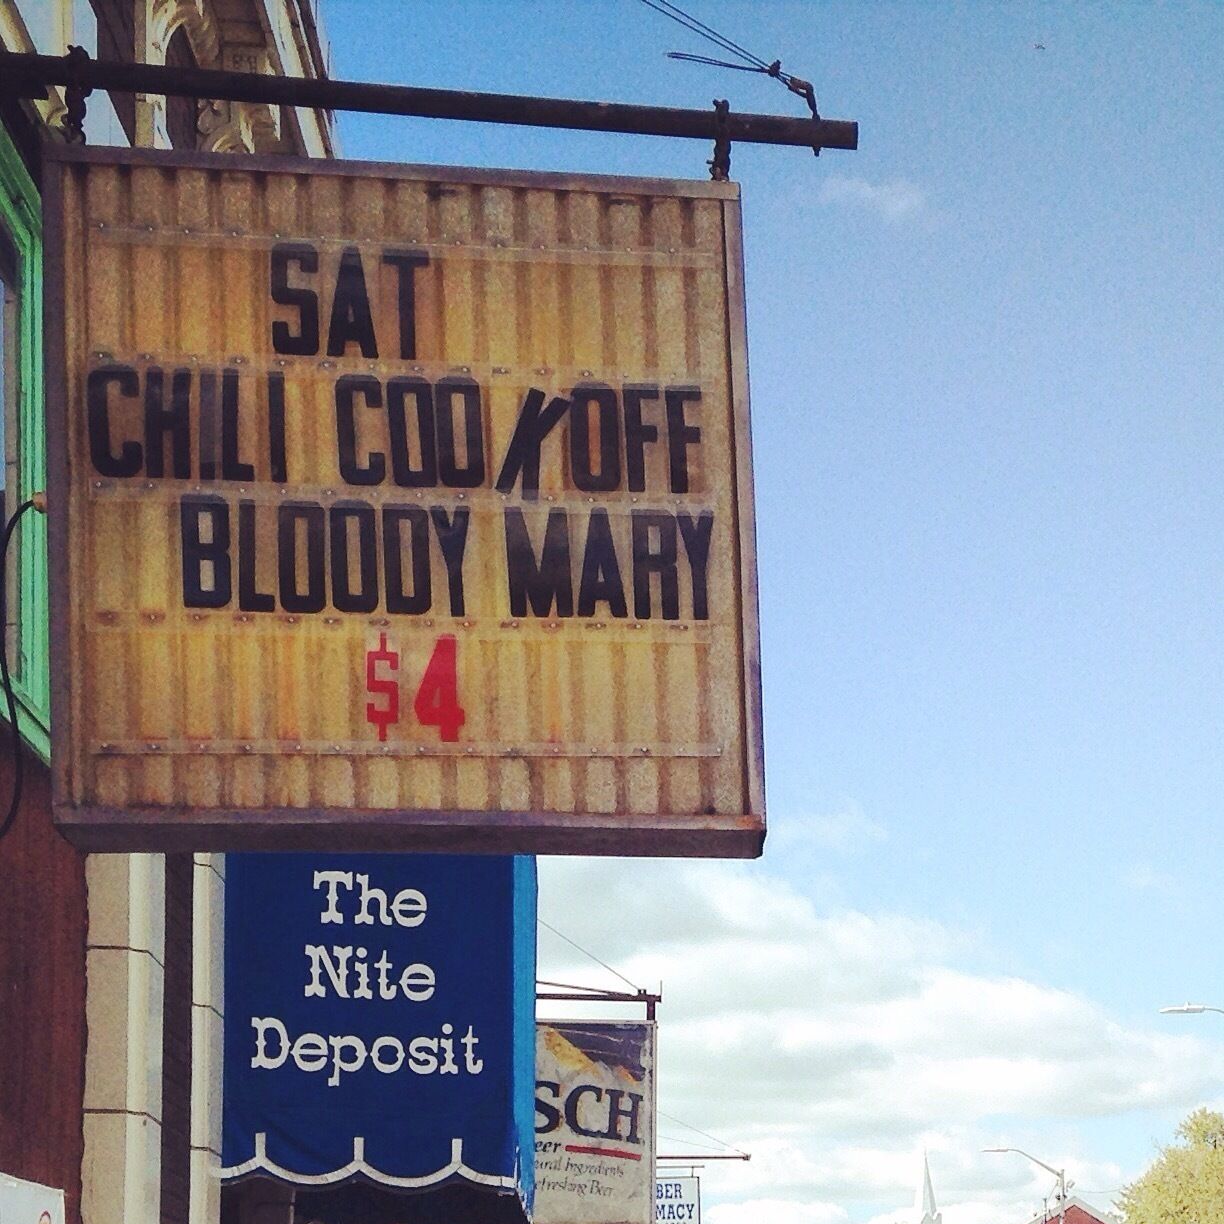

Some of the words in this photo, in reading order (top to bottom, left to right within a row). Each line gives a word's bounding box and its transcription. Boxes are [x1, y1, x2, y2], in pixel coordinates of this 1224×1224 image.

[270, 242, 430, 359] SAT
[87, 364, 288, 483] CHILI
[180, 495, 470, 616] BLOODY
[503, 506, 714, 620] MARY
[366, 633, 465, 742] $4
[313, 870, 427, 927] The
[304, 944, 436, 1001] Nite
[251, 1017, 483, 1086] Deposit
